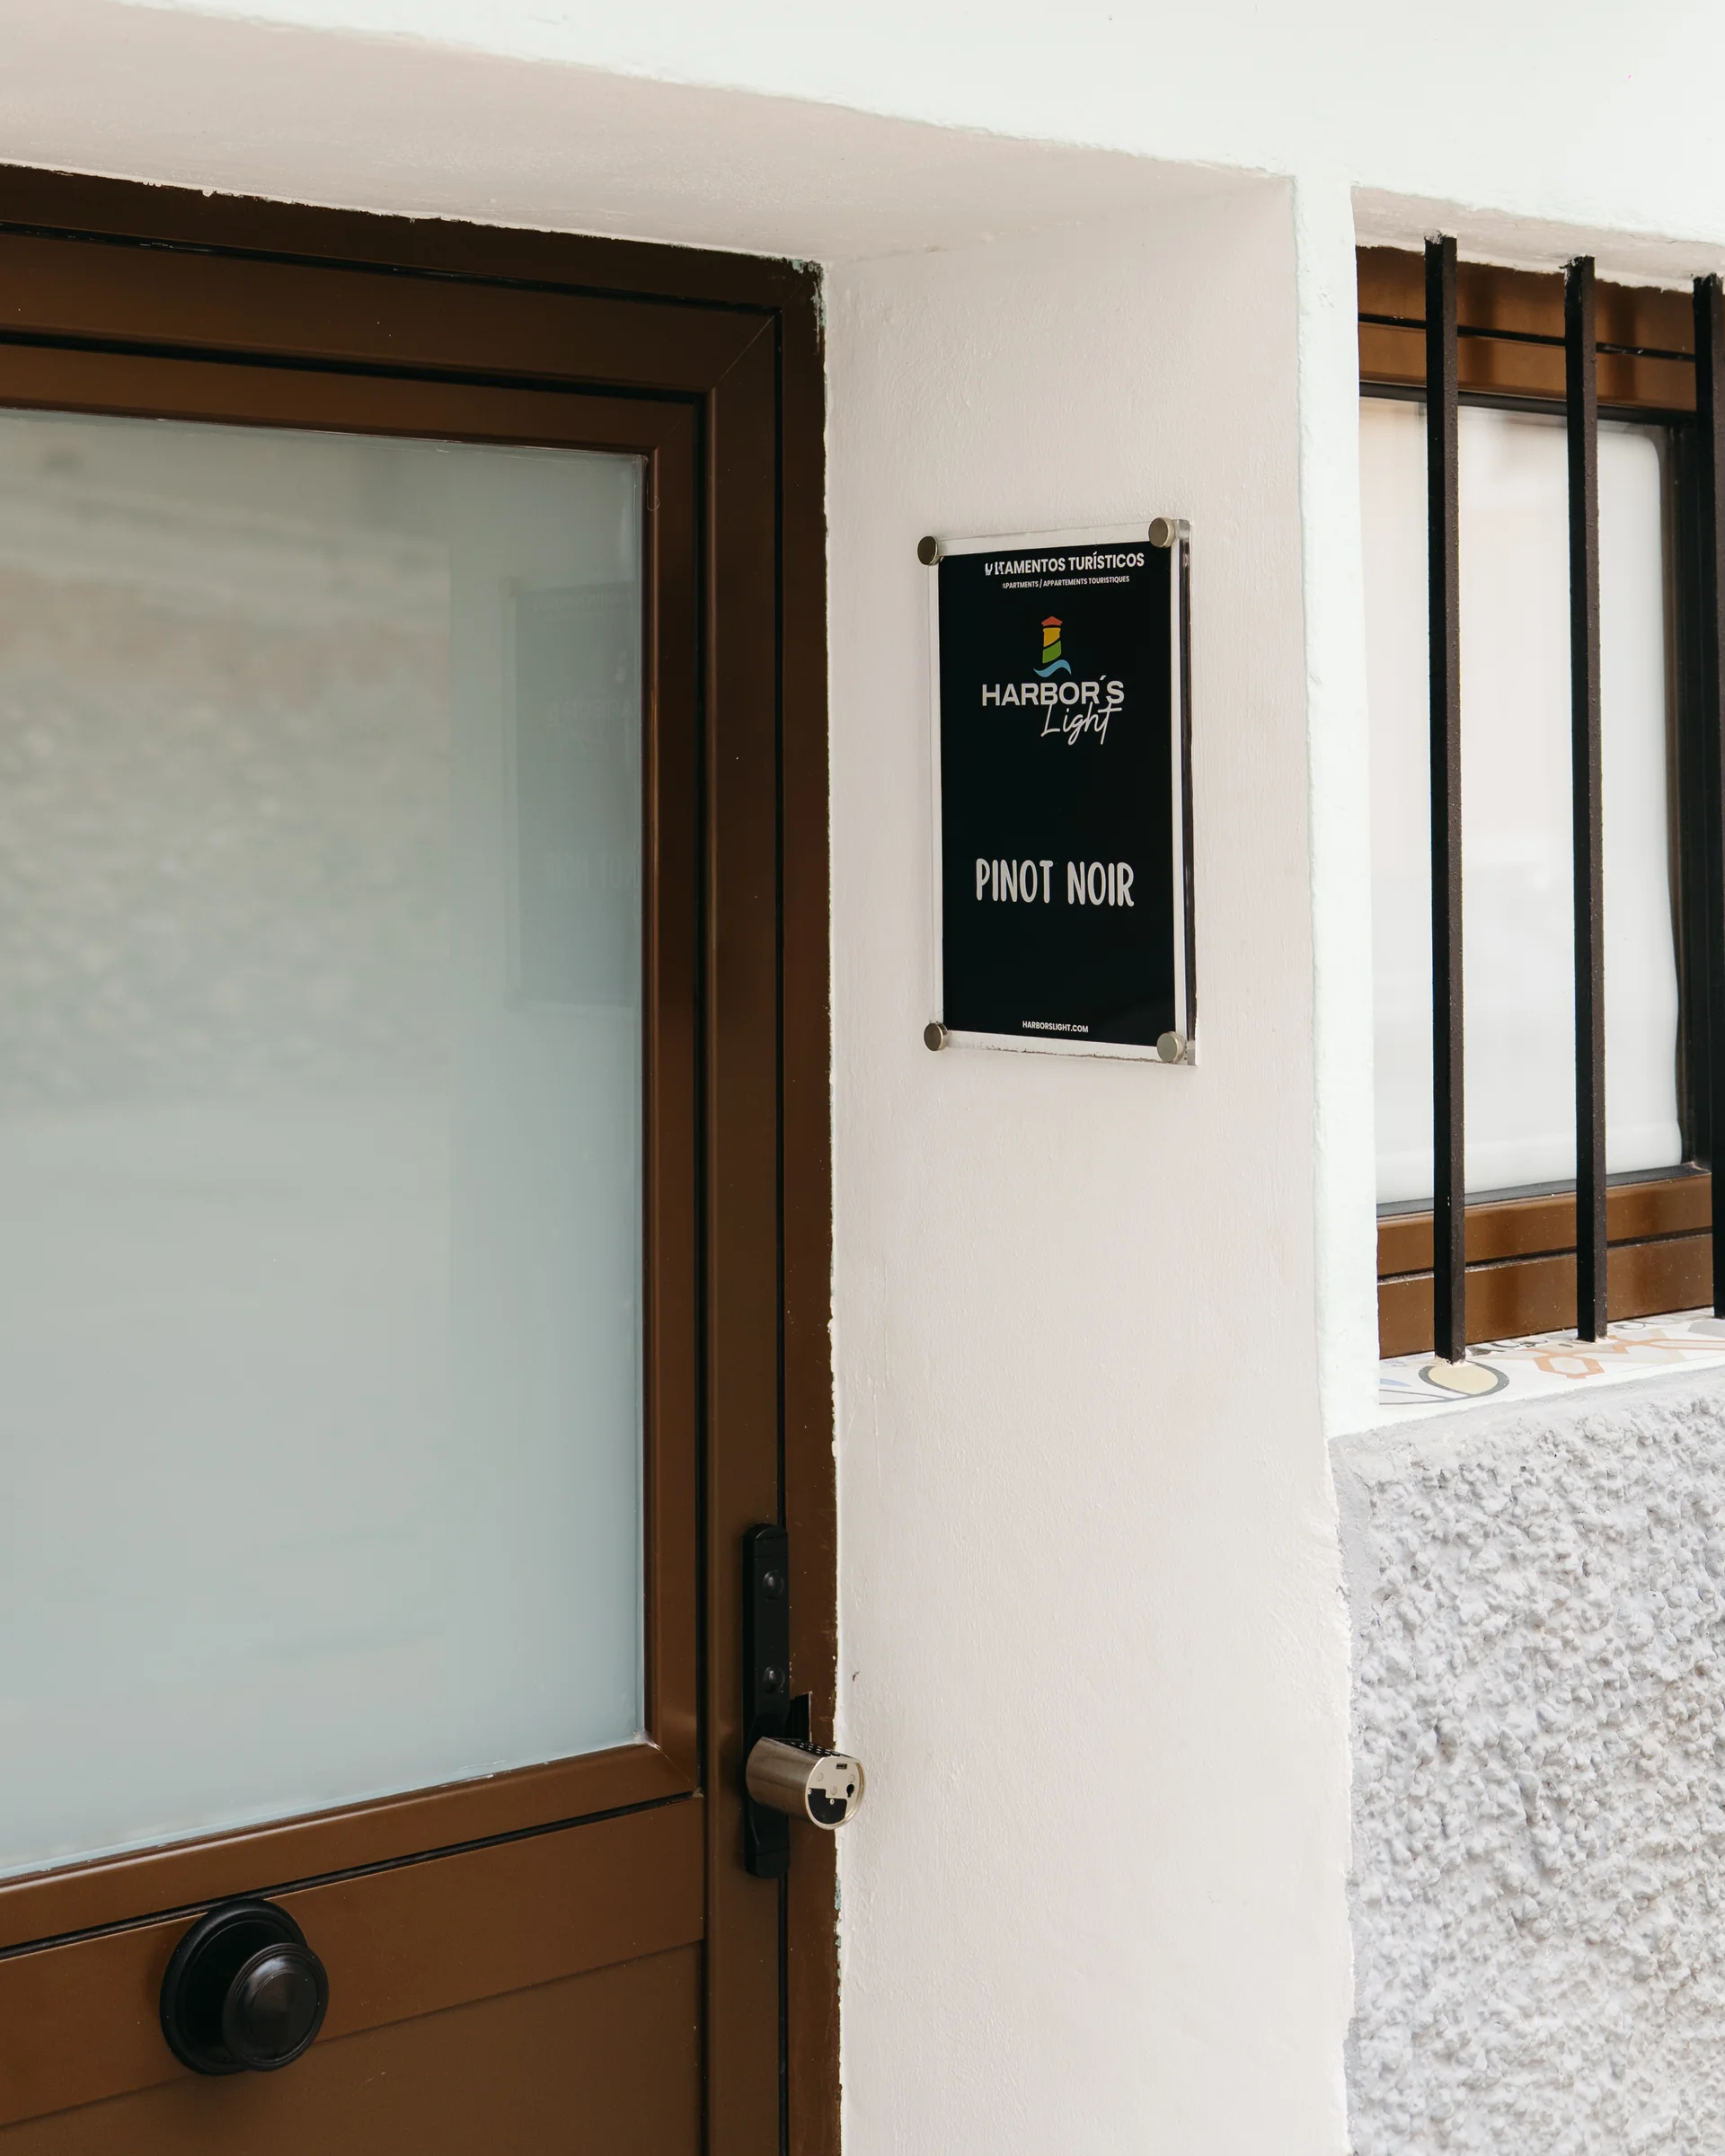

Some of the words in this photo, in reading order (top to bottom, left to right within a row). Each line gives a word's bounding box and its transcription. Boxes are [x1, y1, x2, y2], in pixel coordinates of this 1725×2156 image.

[1068, 551, 1145, 571] TURÍSTICOS
[1002, 580, 1039, 589] APARTMENTS
[1043, 577, 1088, 588] APPARTEMENTS
[1088, 575, 1130, 584] TOURISTIQUES
[1040, 699, 1123, 746] Light
[976, 858, 1055, 904] PINOT
[1066, 860, 1135, 907] NOIR
[1022, 1021, 1089, 1033] HARBORSLIGHT.COM
